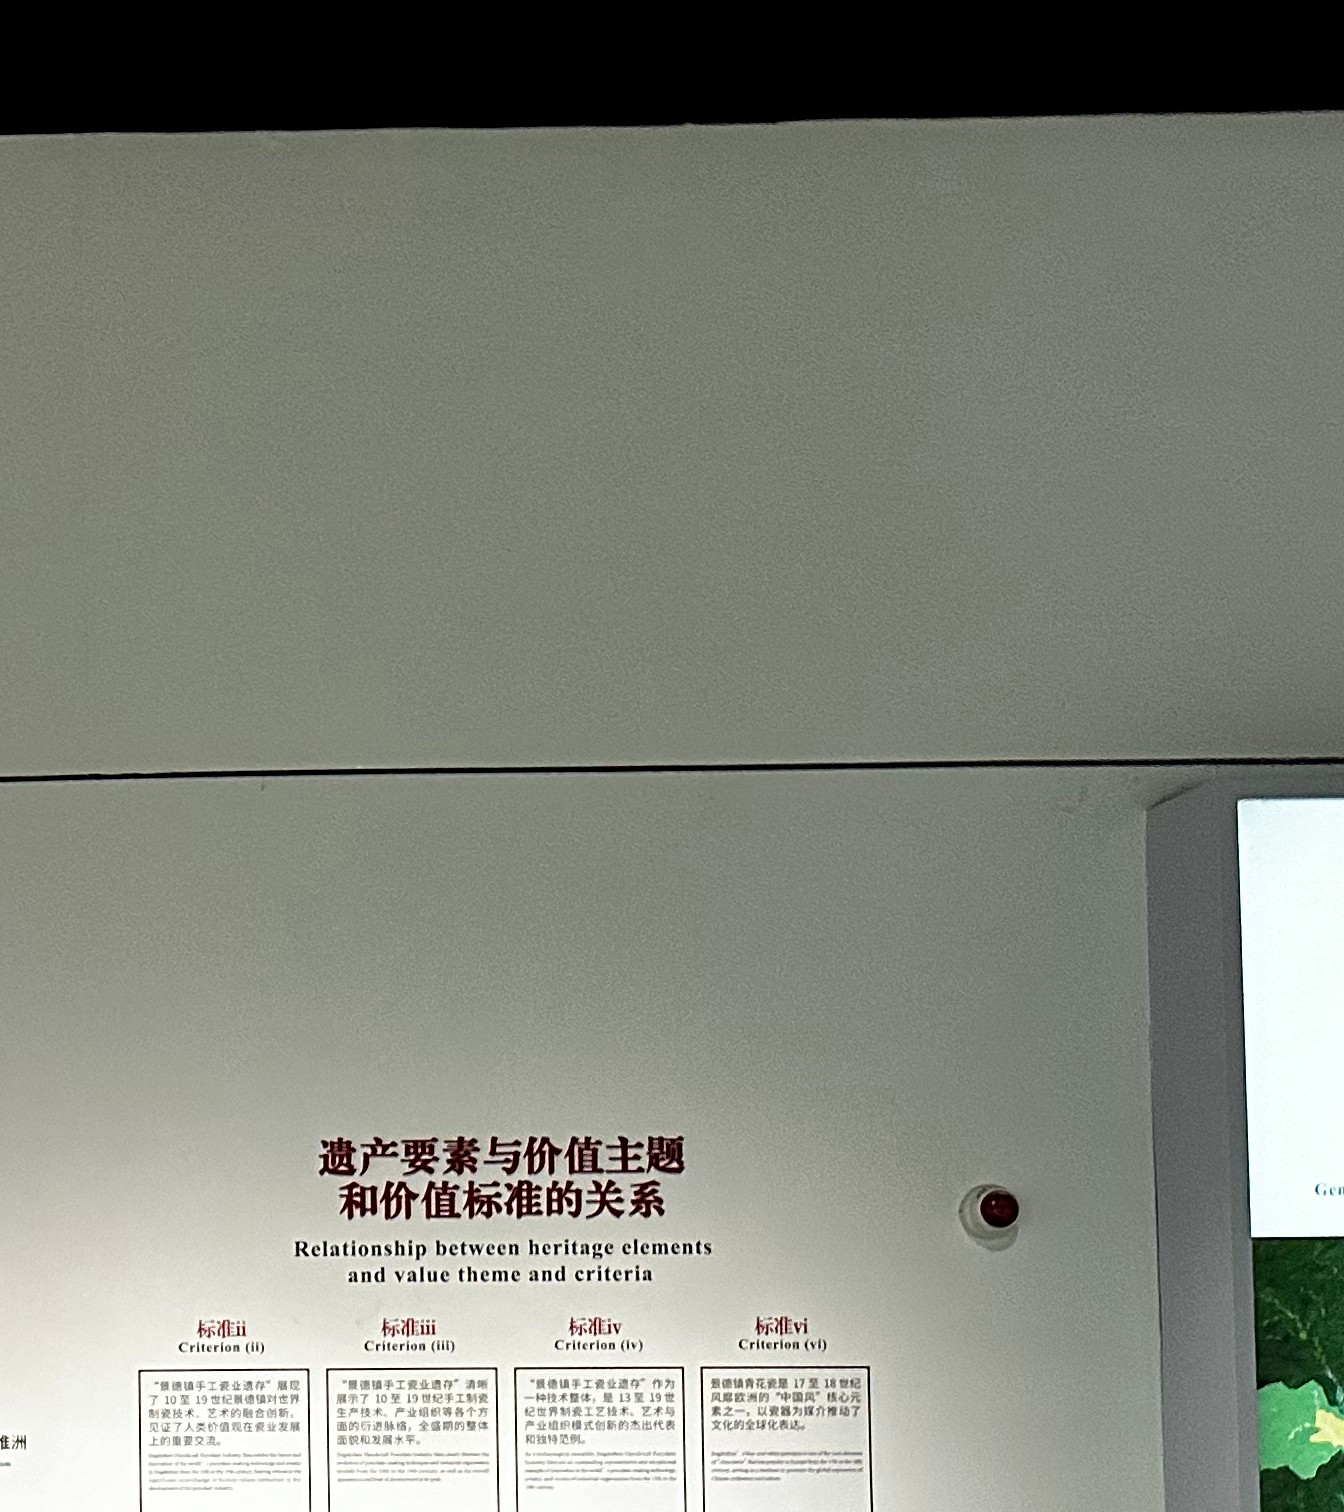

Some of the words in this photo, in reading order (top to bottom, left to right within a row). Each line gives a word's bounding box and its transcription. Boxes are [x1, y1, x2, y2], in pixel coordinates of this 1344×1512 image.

[318, 1135, 686, 1177] 遗产要素与价值主题
[338, 1180, 666, 1221] 和价值标准的关系
[294, 1239, 427, 1261] Relationship
[436, 1239, 520, 1256] between
[528, 1239, 613, 1260] heritage
[621, 1238, 712, 1256] elements
[348, 1266, 385, 1283] and
[395, 1266, 450, 1283] value
[458, 1266, 521, 1283] theme
[529, 1266, 566, 1283] and
[574, 1265, 653, 1283] criteria
[197, 1319, 247, 1339] 标准ii
[381, 1317, 436, 1338] 标准iii
[569, 1316, 622, 1336] 标准iv
[755, 1315, 809, 1336] 标准vi
[178, 1341, 241, 1354] Criterion
[244, 1341, 266, 1355] (ii)
[364, 1340, 427, 1353] Criterion
[430, 1339, 456, 1354] (iii)
[554, 1338, 616, 1351] Criterion
[620, 1338, 644, 1352] (iv)
[738, 1338, 800, 1350] Criterion
[804, 1338, 828, 1351] (vi)
